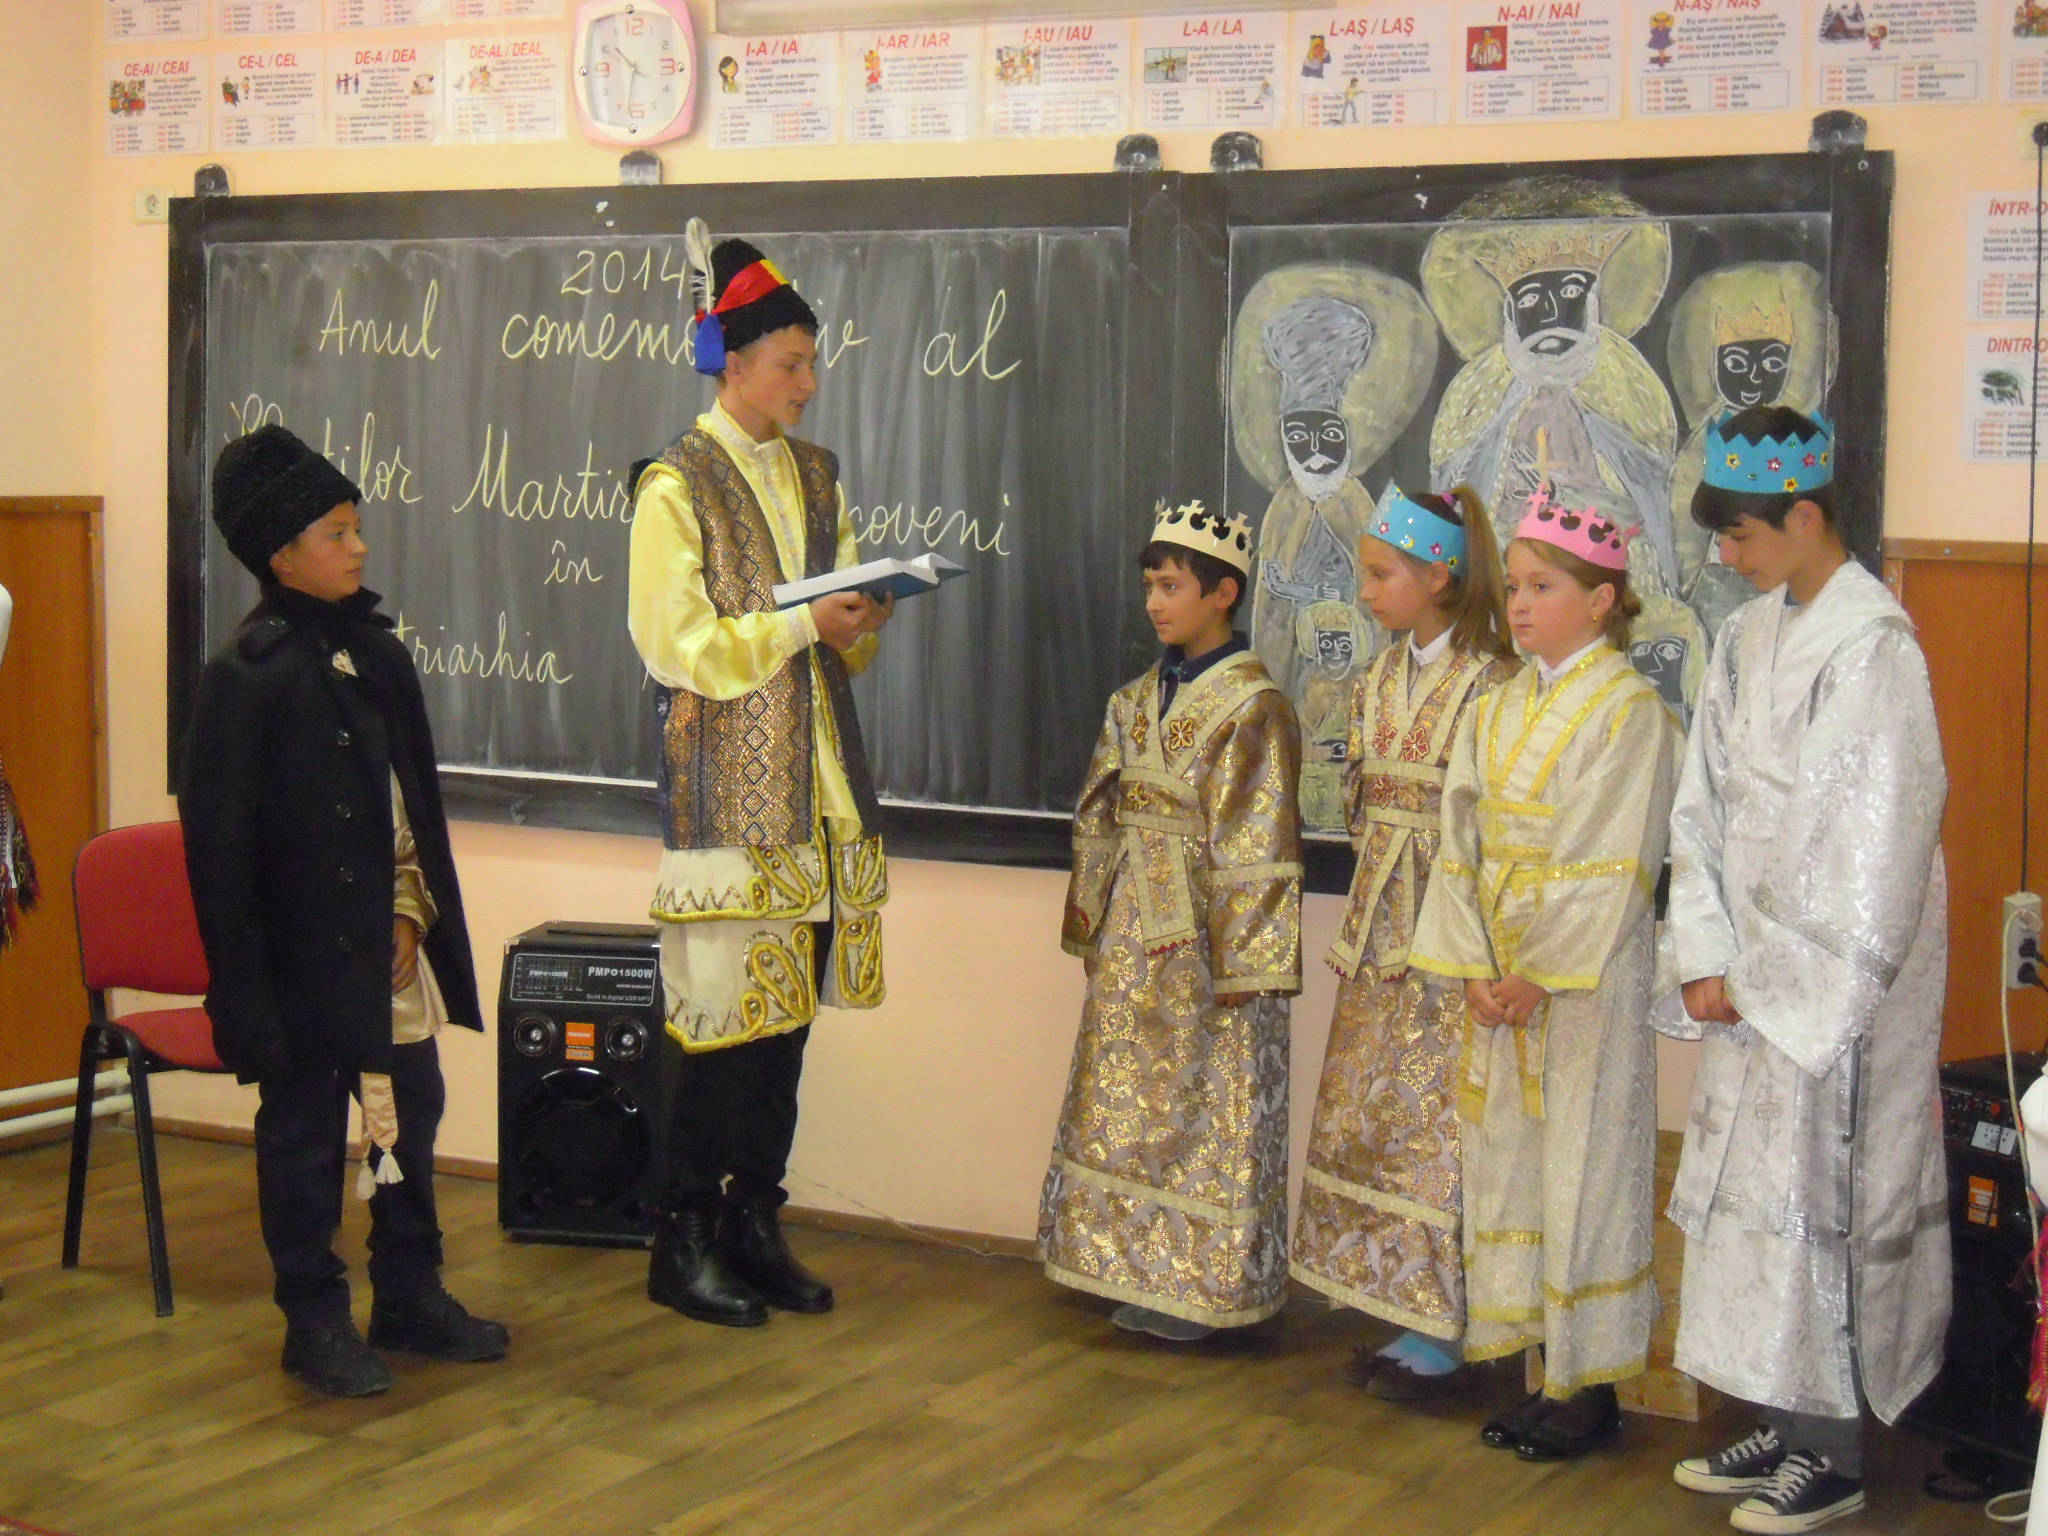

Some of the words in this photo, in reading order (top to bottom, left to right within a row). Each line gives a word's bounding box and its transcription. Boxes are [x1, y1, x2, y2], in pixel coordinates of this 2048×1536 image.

[1498, 4, 1534, 22] N-AI
[1549, 2, 1580, 20] NAI
[625, 18, 644, 36] 12
[1024, 26, 1054, 43] I-AU
[1066, 25, 1093, 41] IAU
[1183, 20, 1208, 37] L-A
[1222, 19, 1243, 35] LA
[662, 40, 669, 50] 2
[746, 41, 768, 56] I-A
[782, 40, 798, 55] IA
[877, 34, 909, 49] I-AR
[922, 32, 950, 47] IAR
[355, 50, 383, 65] DE-A
[392, 49, 417, 63] DEA
[469, 44, 503, 60] DE-AL
[512, 42, 543, 57] DEAL
[124, 63, 155, 77] CE-AI
[162, 61, 189, 75] CEAI
[238, 55, 265, 70] CE-L
[275, 53, 298, 68] CEL
[660, 58, 675, 76] 3
[561, 245, 687, 300] 2014
[319, 278, 443, 360] Anul
[923, 288, 1022, 381] al
[453, 423, 633, 523] Martir
[544, 539, 603, 585] în
[588, 966, 653, 979] PMPO1500W
